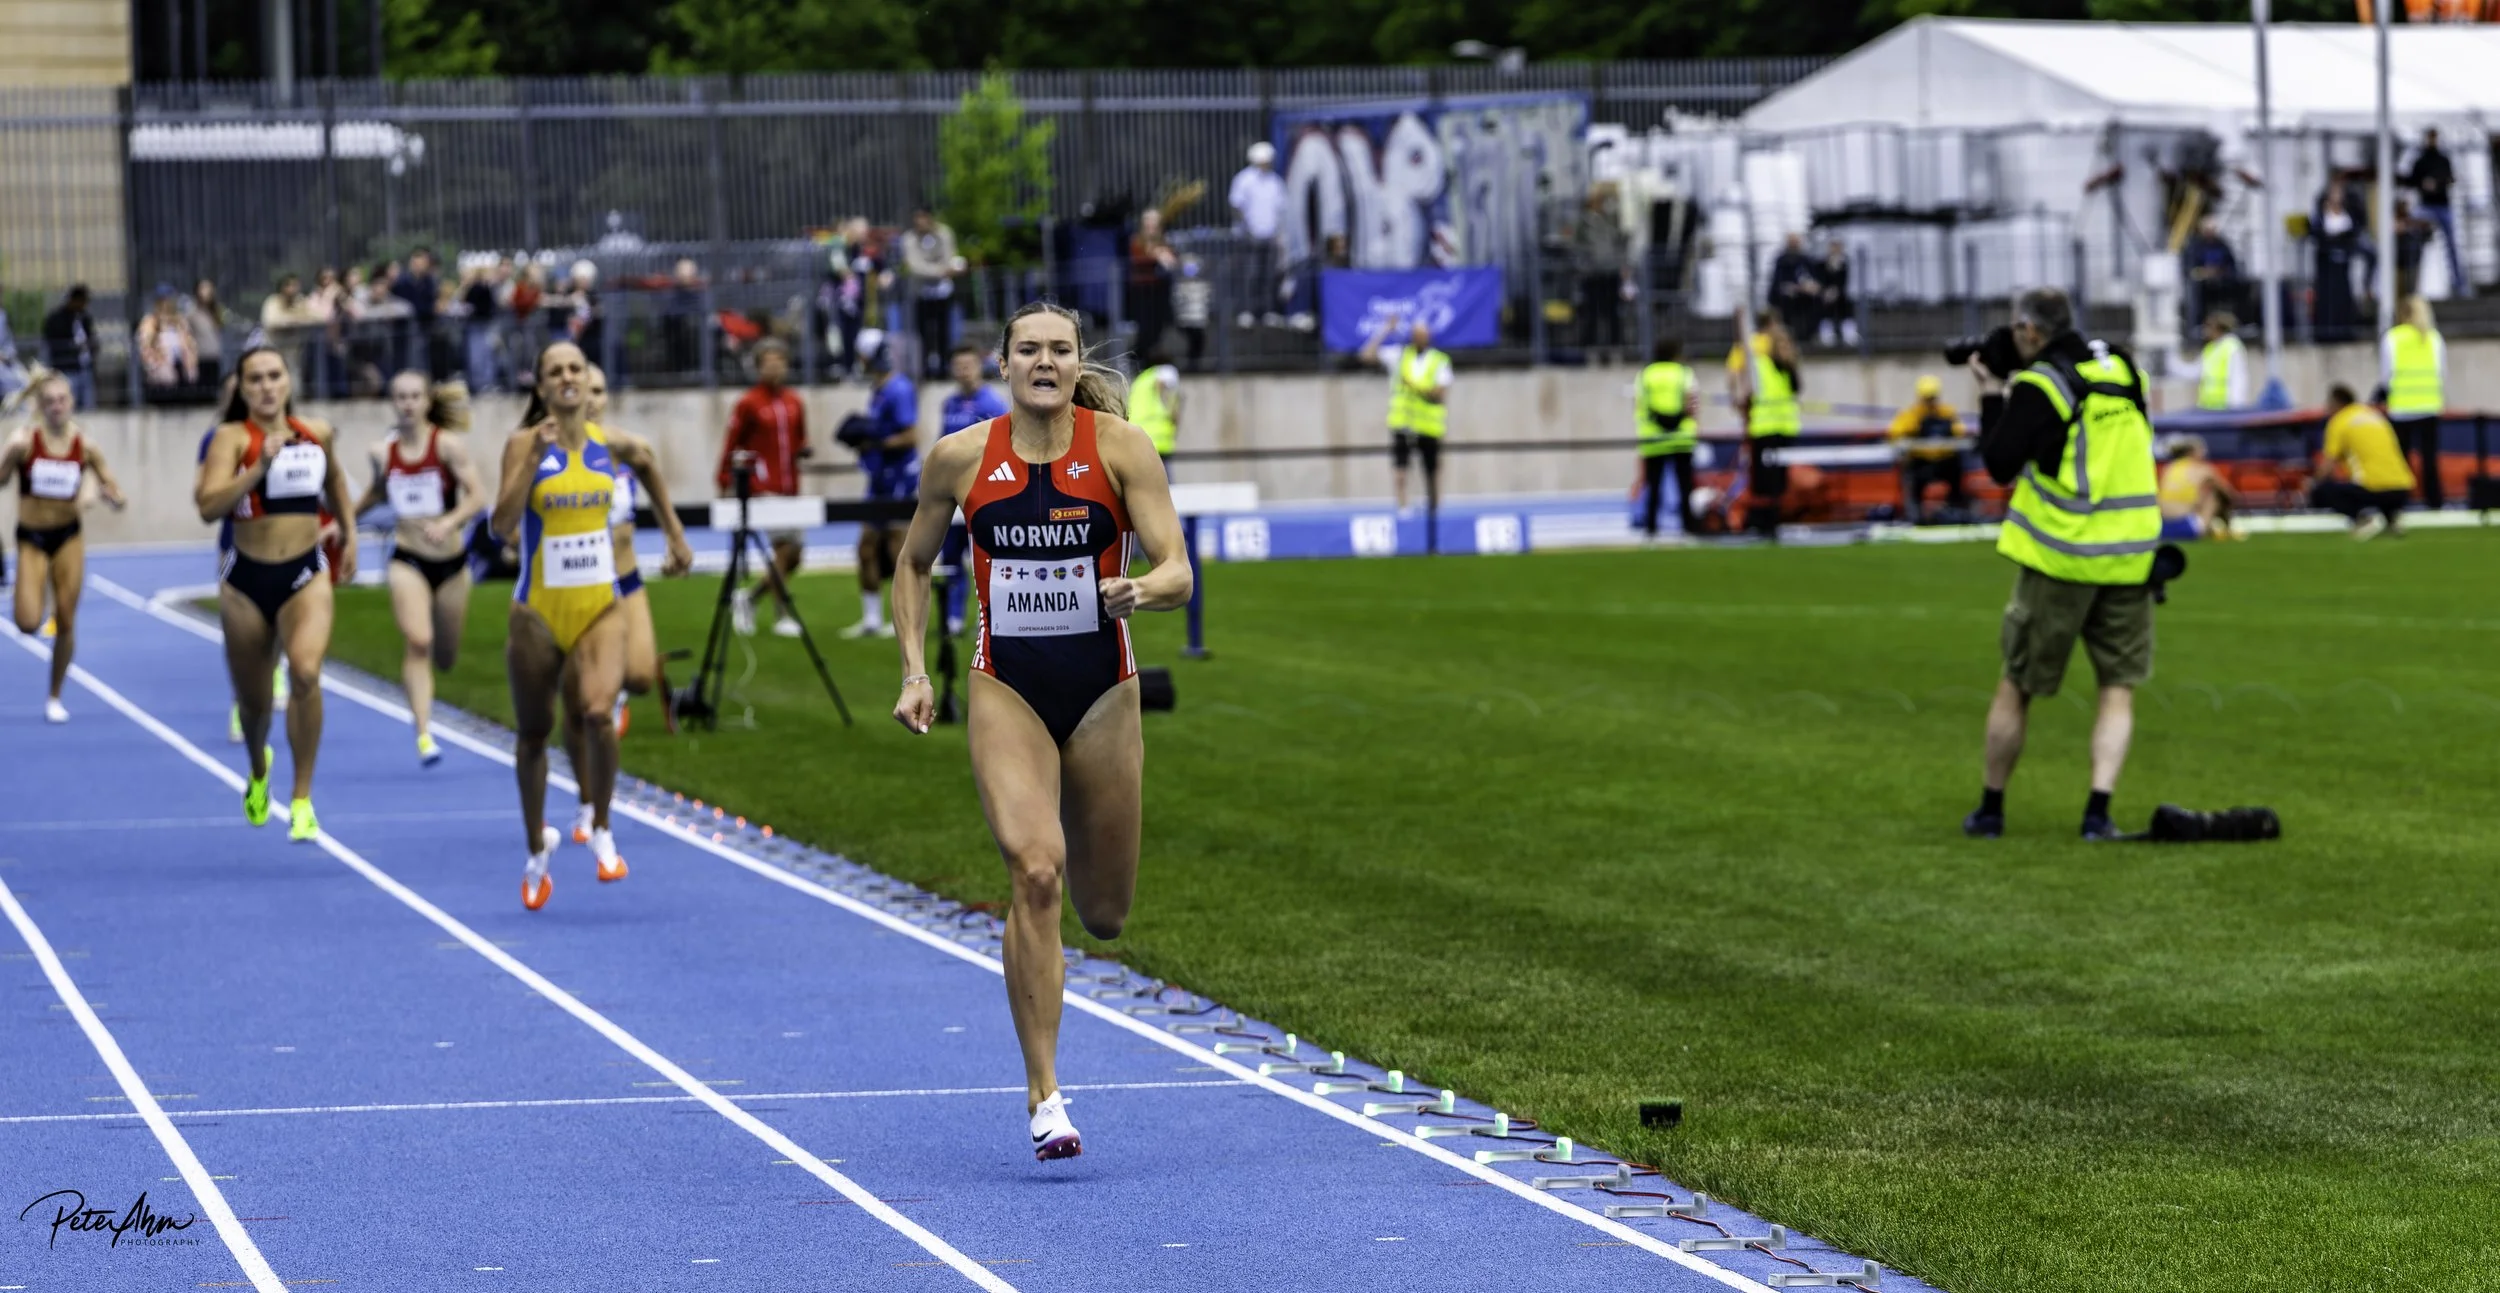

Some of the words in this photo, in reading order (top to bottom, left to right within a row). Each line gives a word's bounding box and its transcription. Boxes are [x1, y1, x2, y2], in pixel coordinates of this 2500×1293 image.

[542, 490, 610, 510] SWEDEN
[1063, 510, 1086, 518] EXTRA
[993, 523, 1091, 548] NORWAY
[561, 555, 598, 571] MARIA
[1007, 591, 1079, 613] AMANDA
